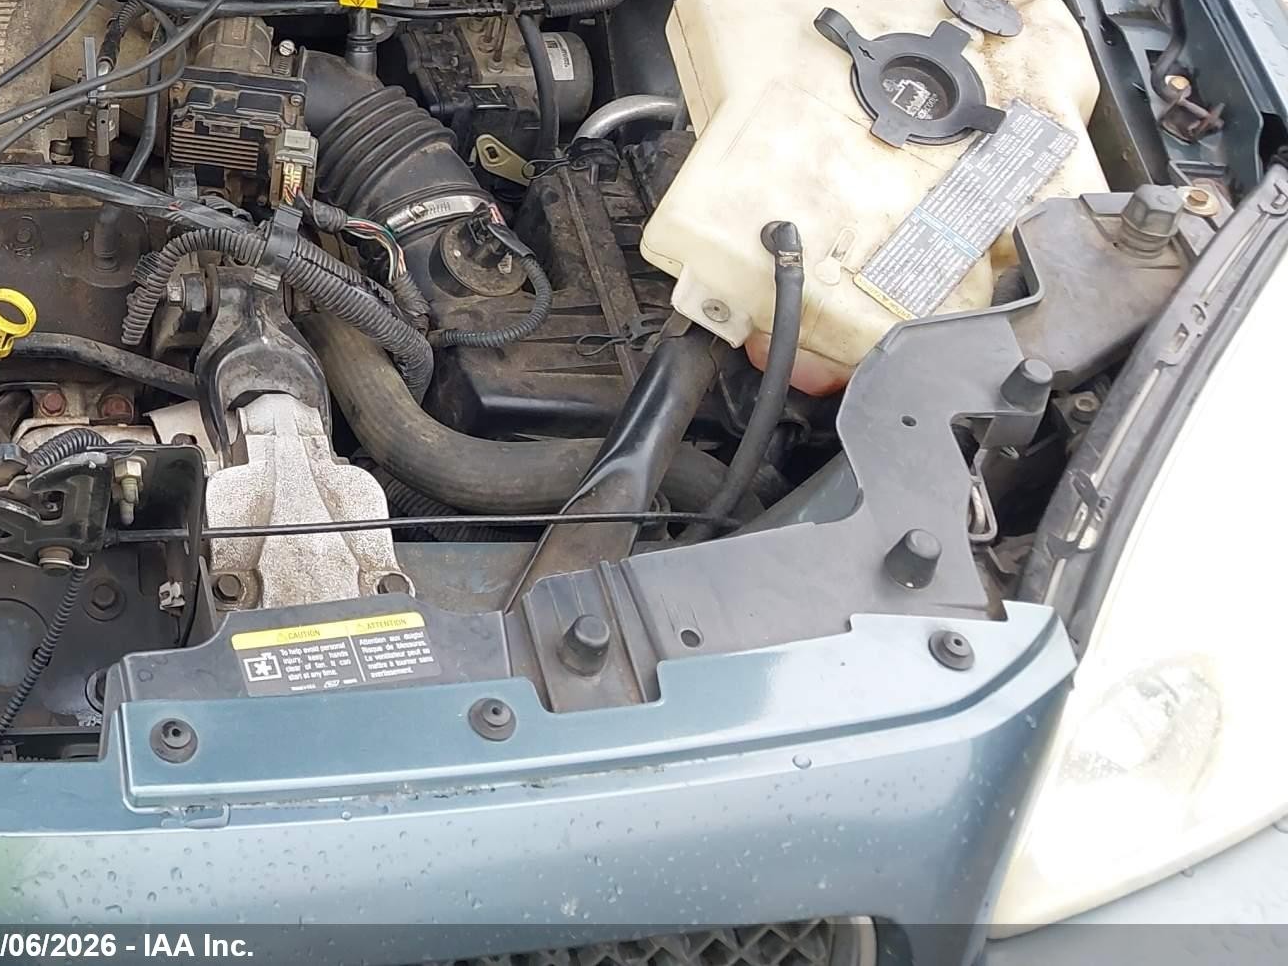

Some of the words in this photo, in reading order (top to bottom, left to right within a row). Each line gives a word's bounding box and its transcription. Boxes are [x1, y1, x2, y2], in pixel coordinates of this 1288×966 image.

[367, 619, 407, 630] ATTENTION
[288, 629, 321, 640] CAUTION
[359, 636, 386, 645] Attention
[288, 648, 302, 656] help
[320, 642, 346, 652] personal
[329, 650, 349, 658] hands
[311, 671, 322, 679] any
